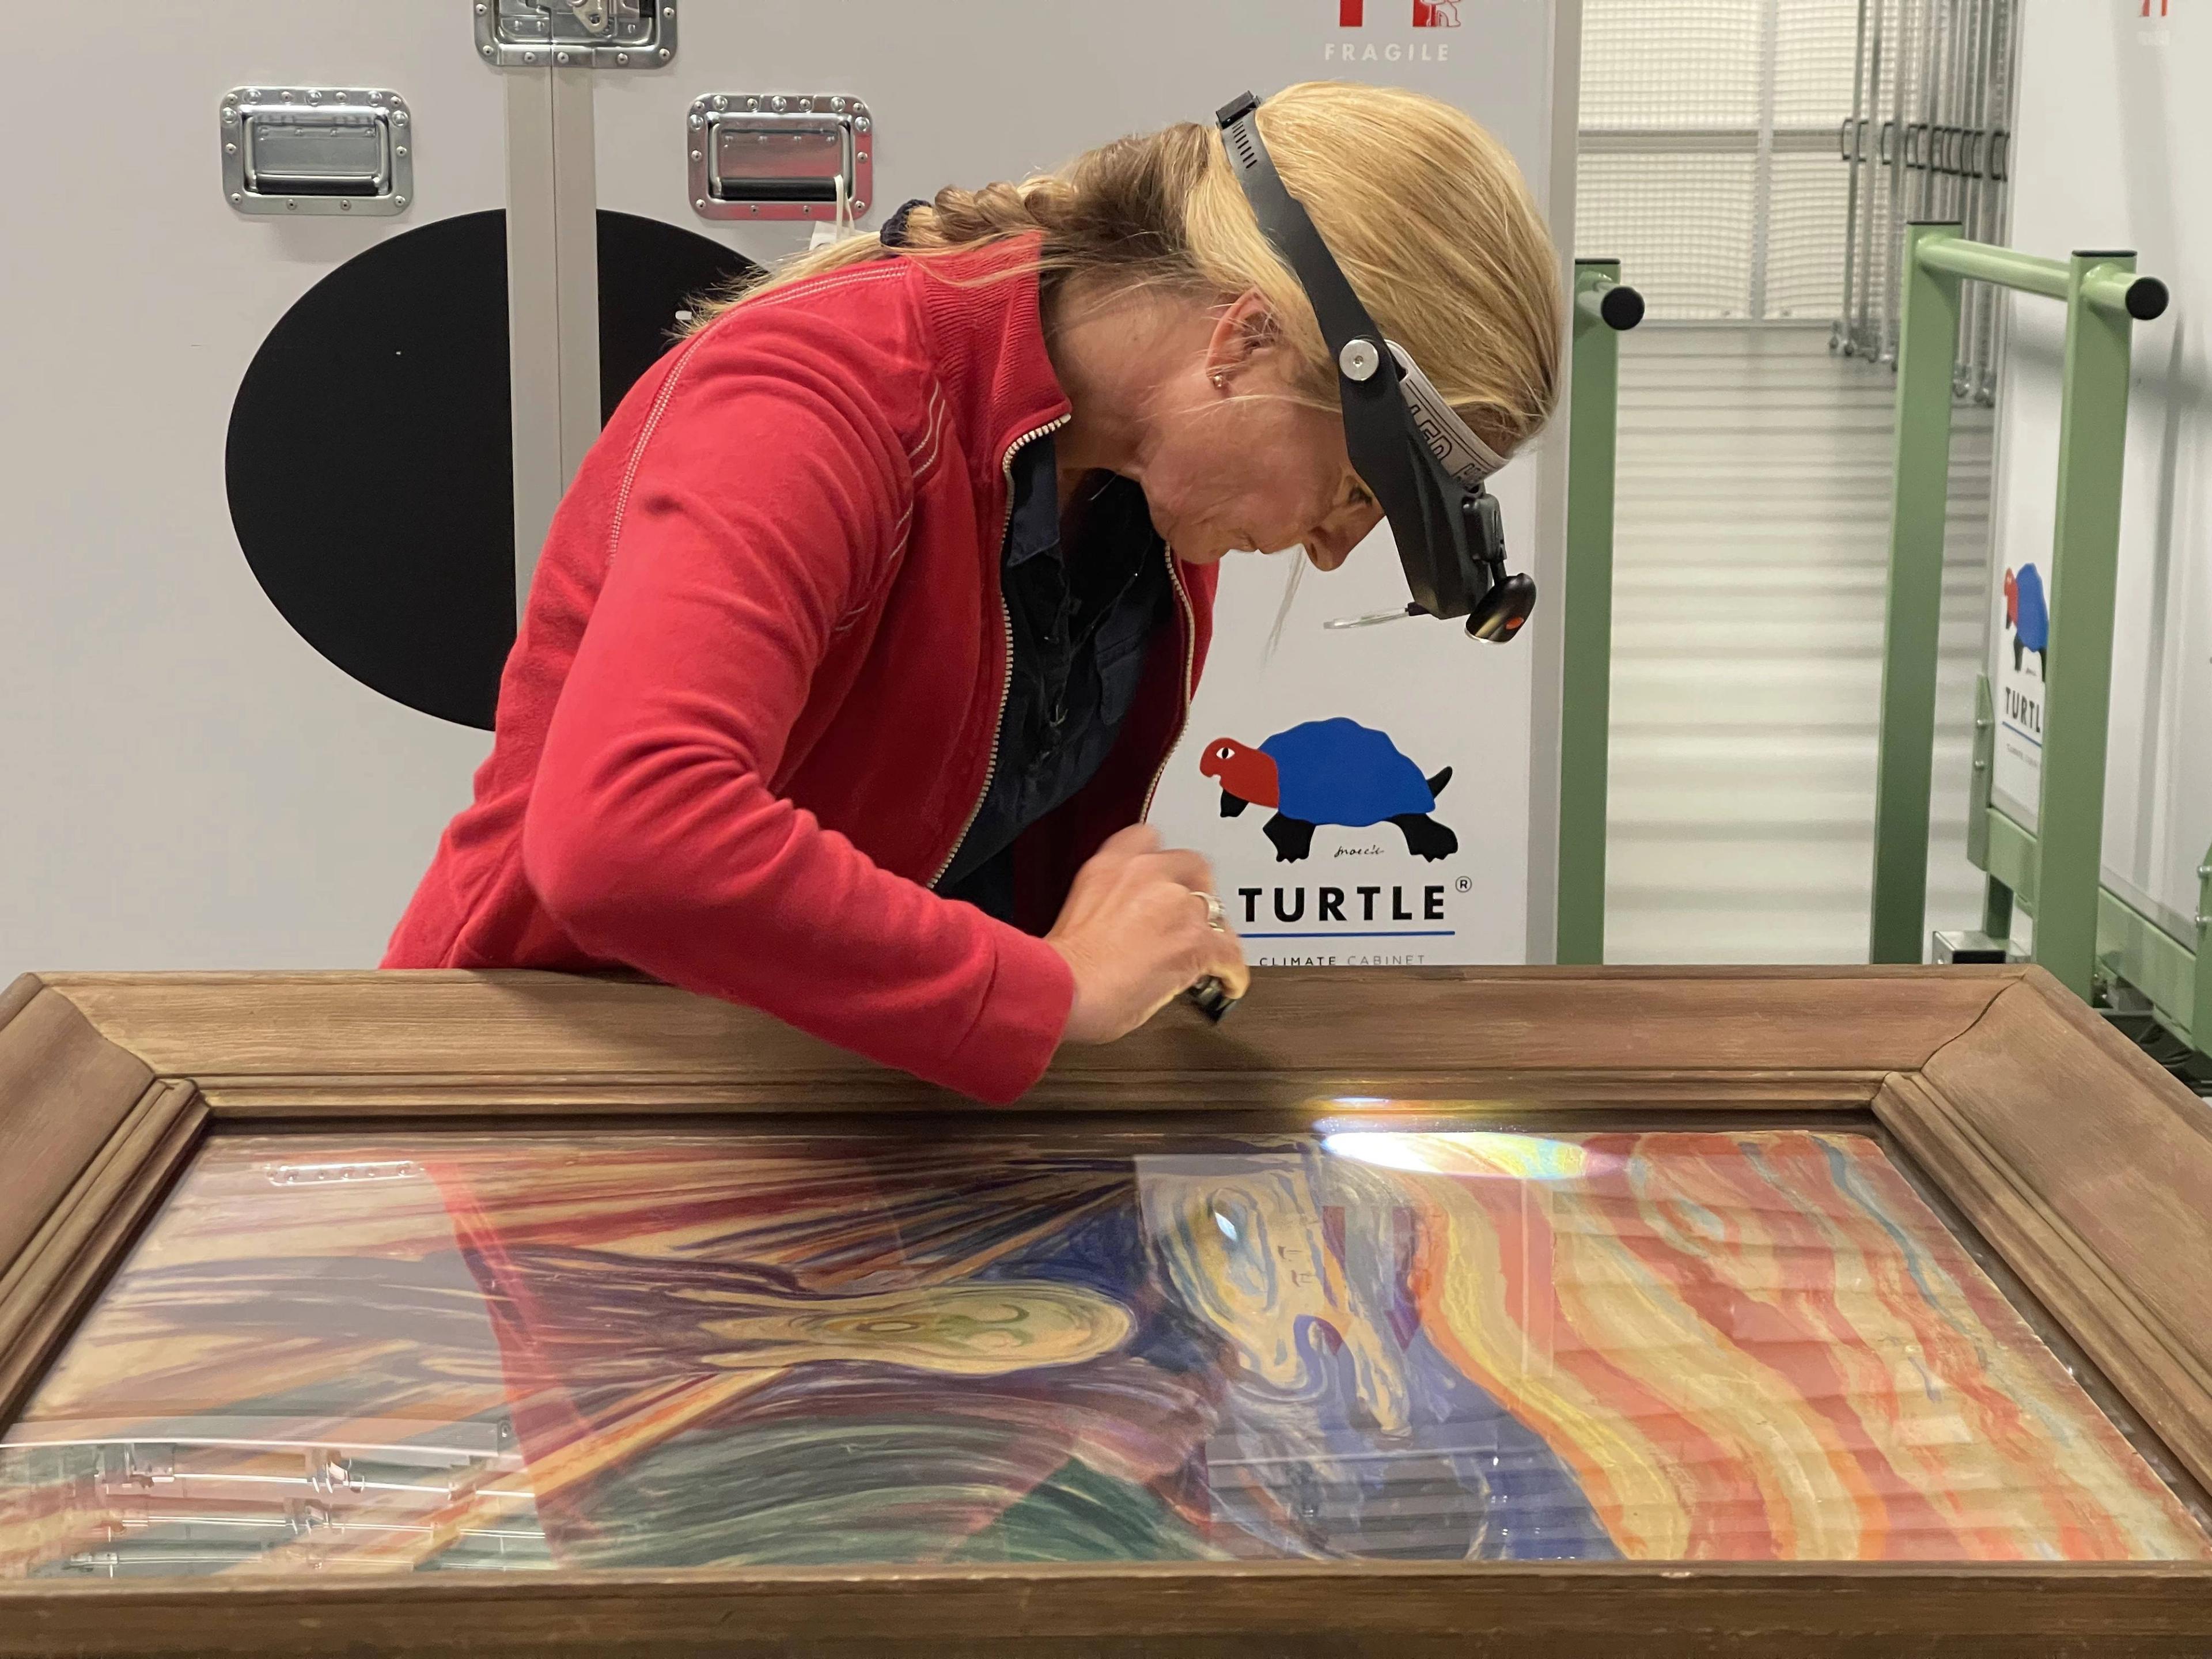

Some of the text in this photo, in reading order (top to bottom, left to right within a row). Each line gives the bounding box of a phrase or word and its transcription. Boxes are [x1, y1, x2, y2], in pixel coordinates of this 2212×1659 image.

[1325, 43, 1448, 62] FRAGILE
[2005, 686, 2041, 733] TURTL
[1238, 885, 1445, 922] TURTLE
[1259, 955, 1425, 966] CLIMATE CABINET
